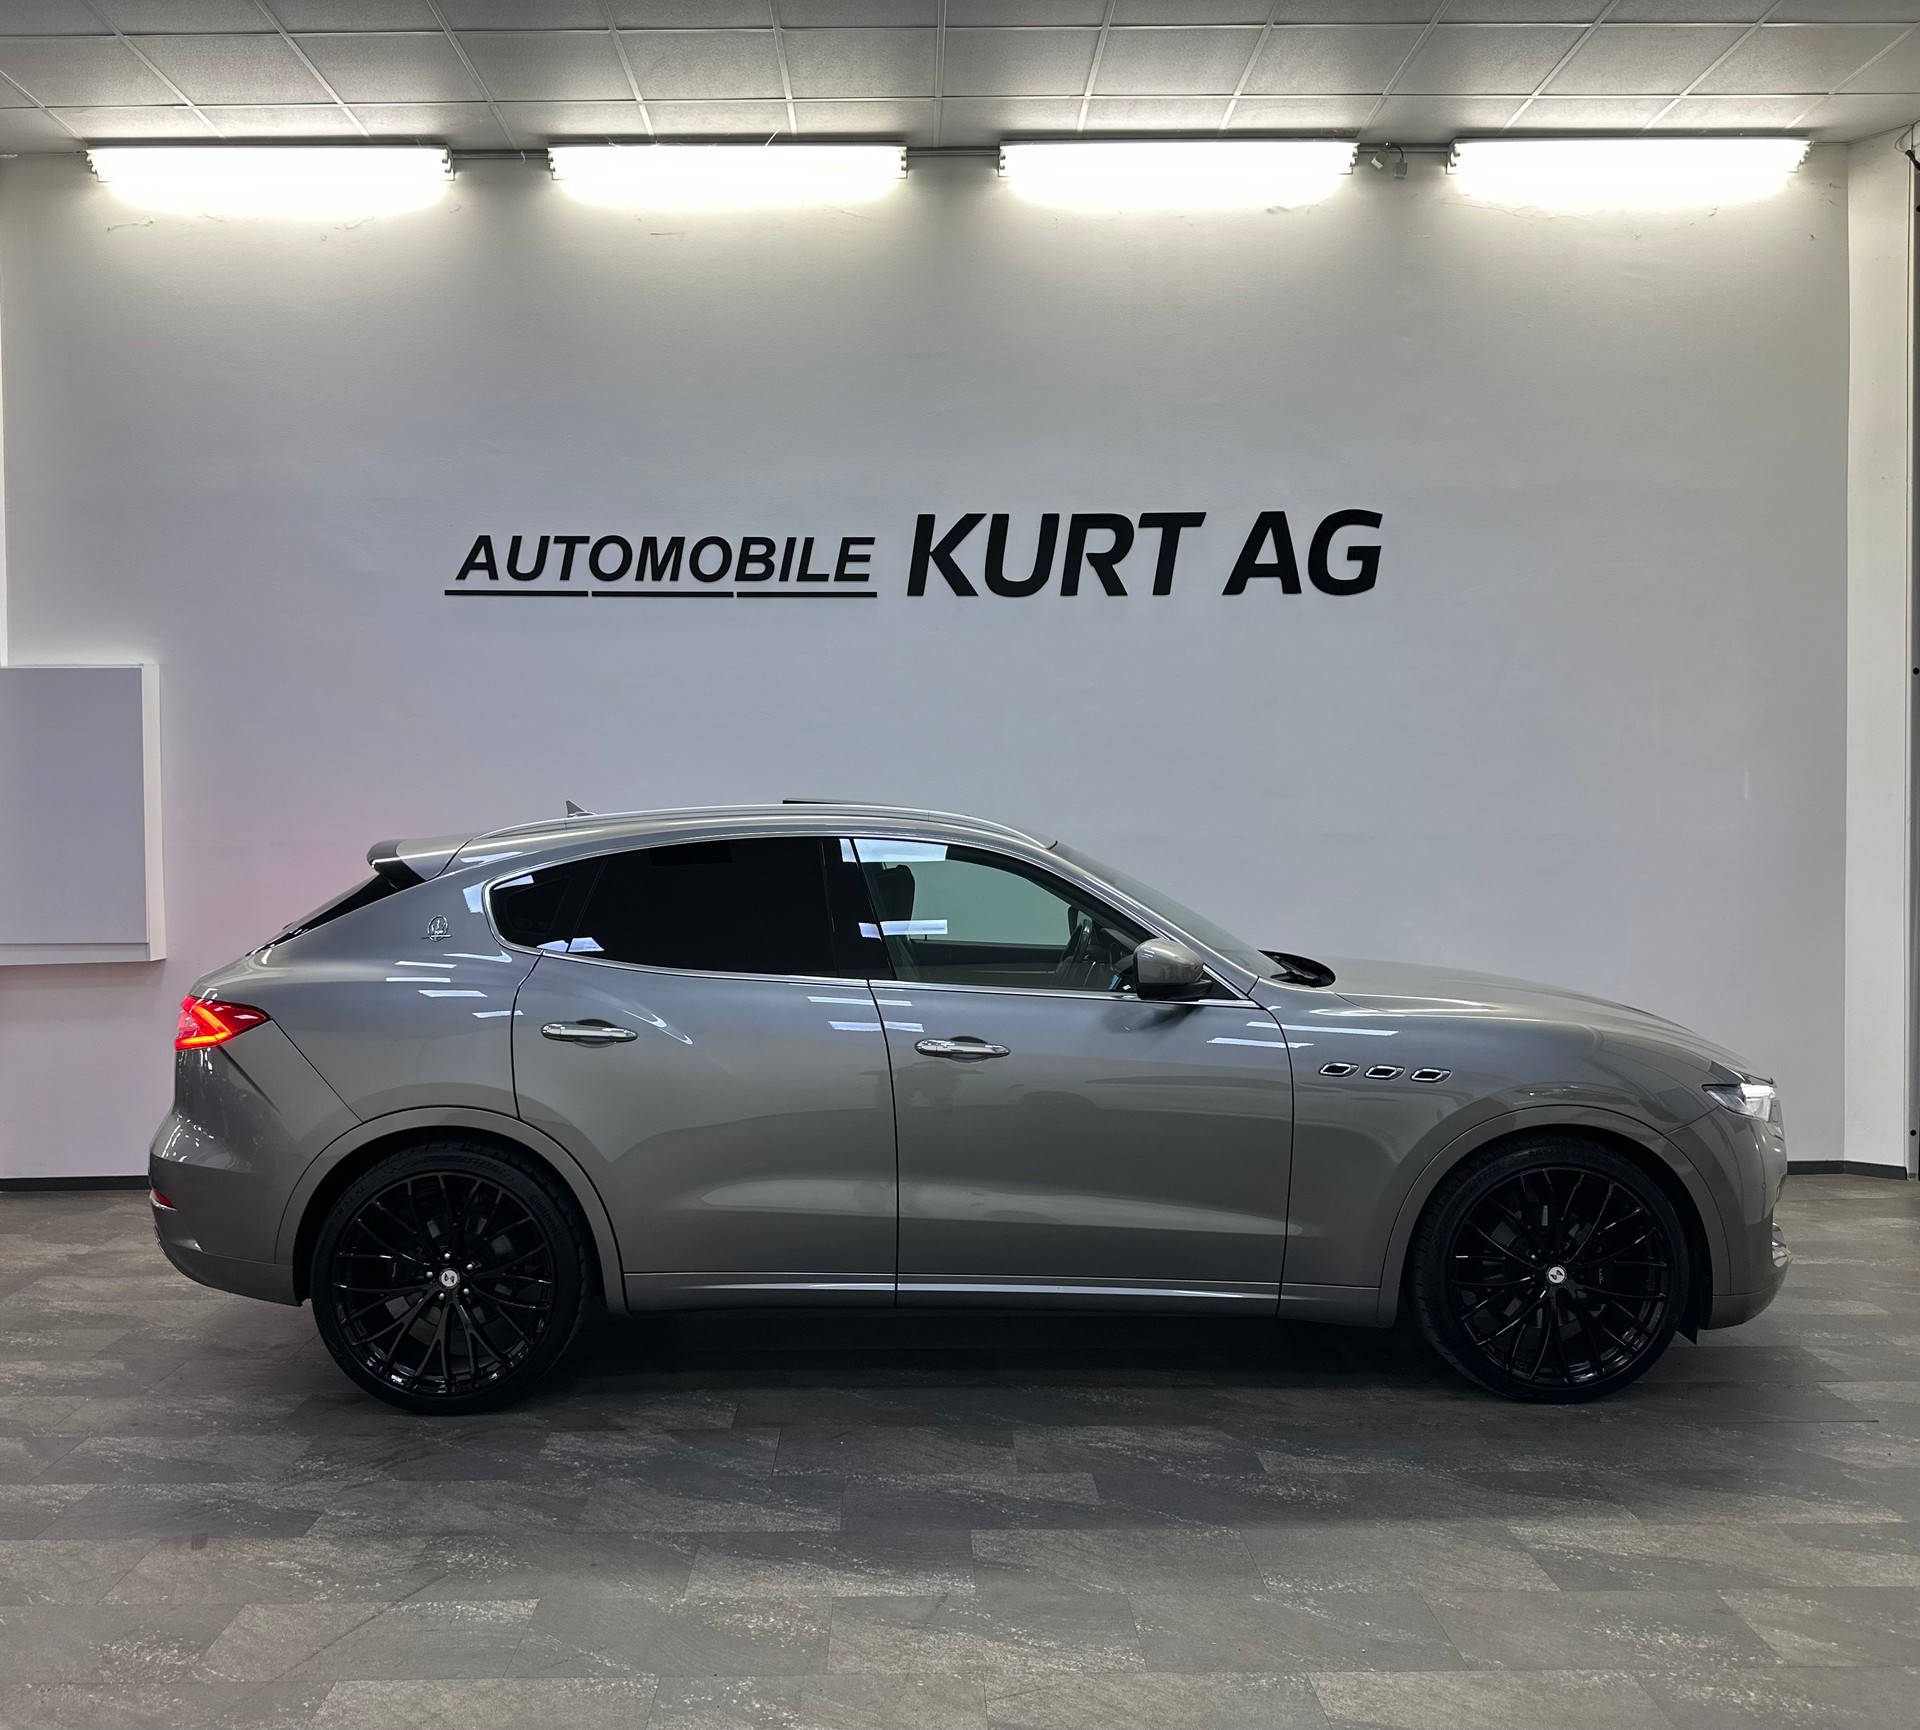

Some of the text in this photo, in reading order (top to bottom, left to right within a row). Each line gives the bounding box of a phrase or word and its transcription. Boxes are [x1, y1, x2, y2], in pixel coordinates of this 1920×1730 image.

[456, 508, 1384, 598] AUTOMOBILE KURT AG
